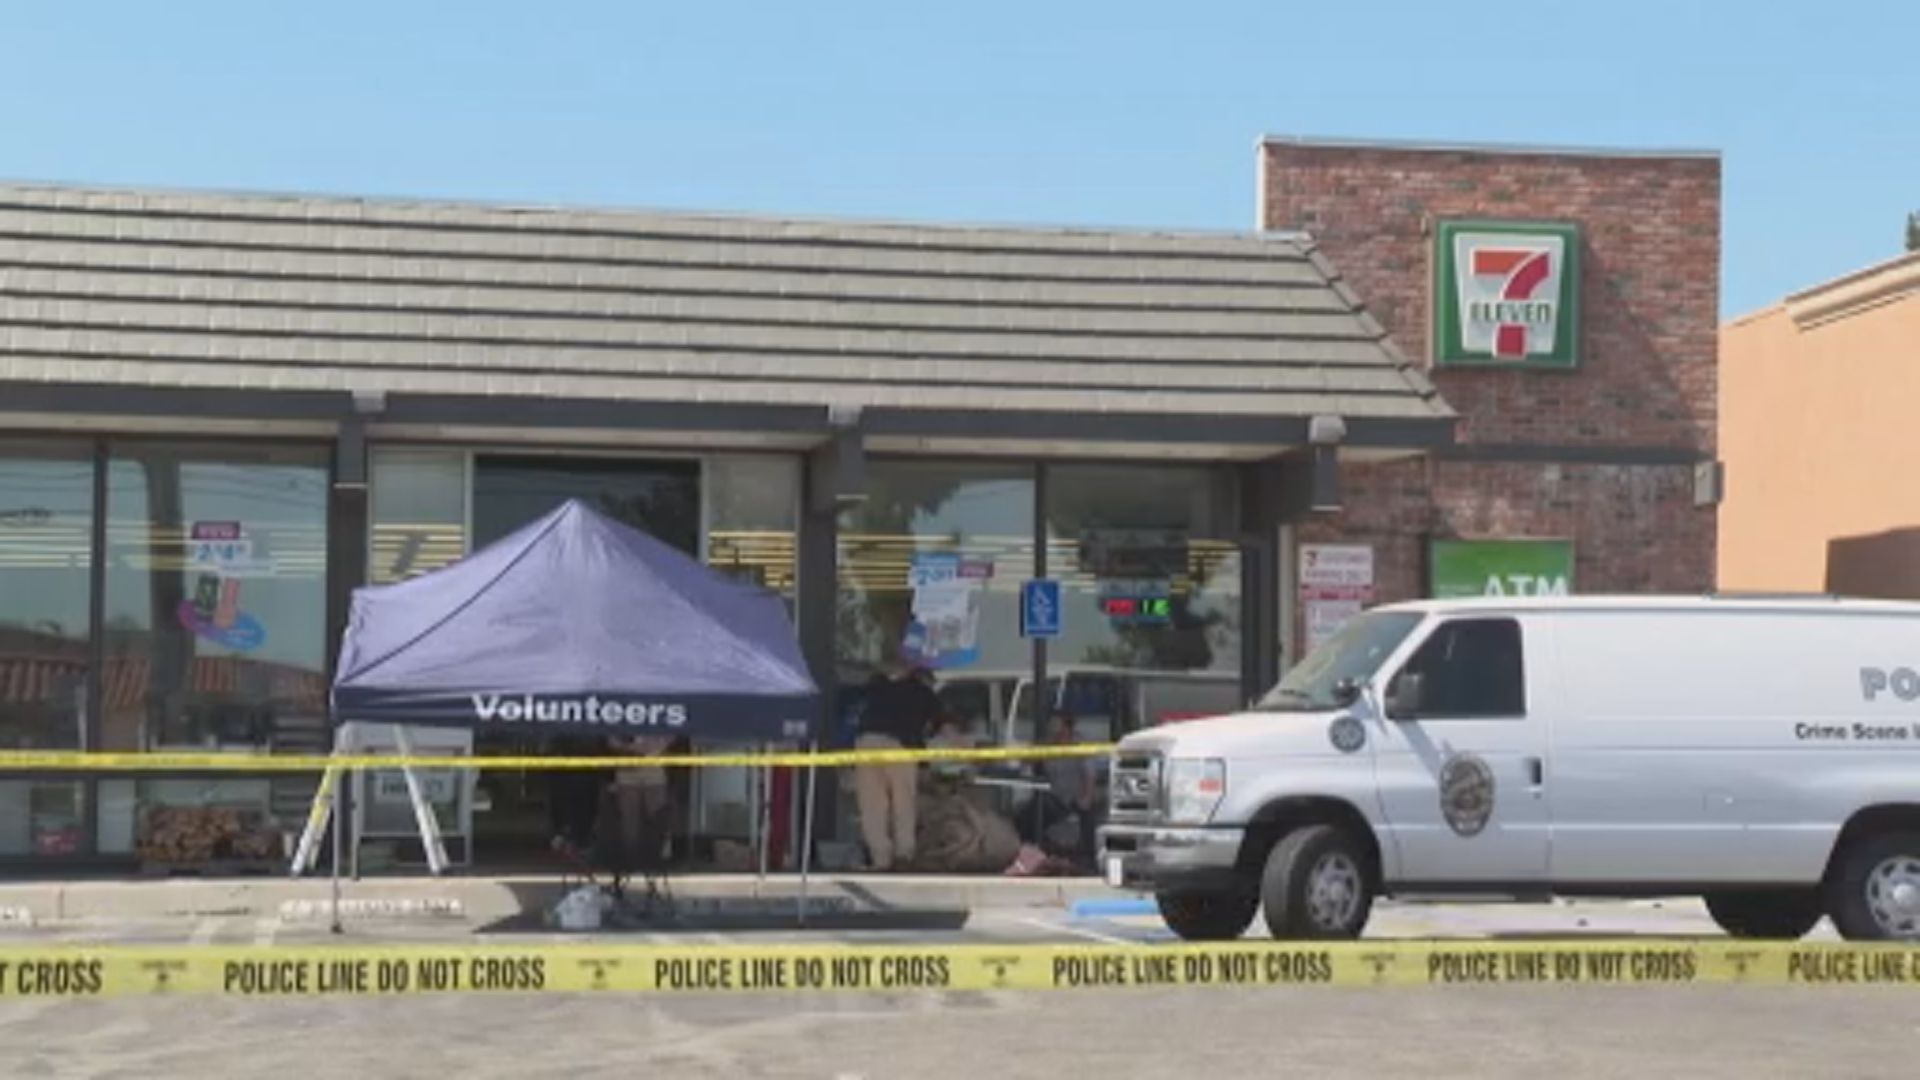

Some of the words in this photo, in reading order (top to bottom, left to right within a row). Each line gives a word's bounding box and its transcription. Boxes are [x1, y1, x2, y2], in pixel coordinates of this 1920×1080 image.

[1472, 249, 1551, 358] 7
[1485, 574, 1567, 597] ATM
[1859, 666, 1920, 701] PO
[472, 694, 688, 726] Volunteers
[1795, 722, 1847, 739] Crime
[1852, 722, 1908, 739] Scene
[17, 960, 103, 994] CROSS
[224, 961, 308, 993] POLICE
[318, 961, 368, 991] LINE
[377, 960, 409, 991] DO
[418, 958, 462, 991] NOT
[470, 957, 545, 990] CROSS
[655, 958, 732, 989] POLICE
[741, 958, 786, 988] LINE
[795, 957, 825, 987] DO
[832, 957, 873, 986] NOT
[880, 956, 950, 986] CROSS
[1053, 955, 1127, 986] POLICE
[1133, 955, 1177, 983] LINE
[1184, 954, 1211, 982] DO
[1218, 953, 1258, 982] NOT
[1265, 952, 1333, 982] CROSS
[1428, 953, 1498, 982] POLICE
[1505, 953, 1547, 980] LINE
[1555, 952, 1580, 980] DO
[1588, 952, 1624, 980] NOT
[1631, 951, 1696, 979] CROSS
[1788, 952, 1857, 981] POLICE
[1864, 952, 1906, 981] LINE
